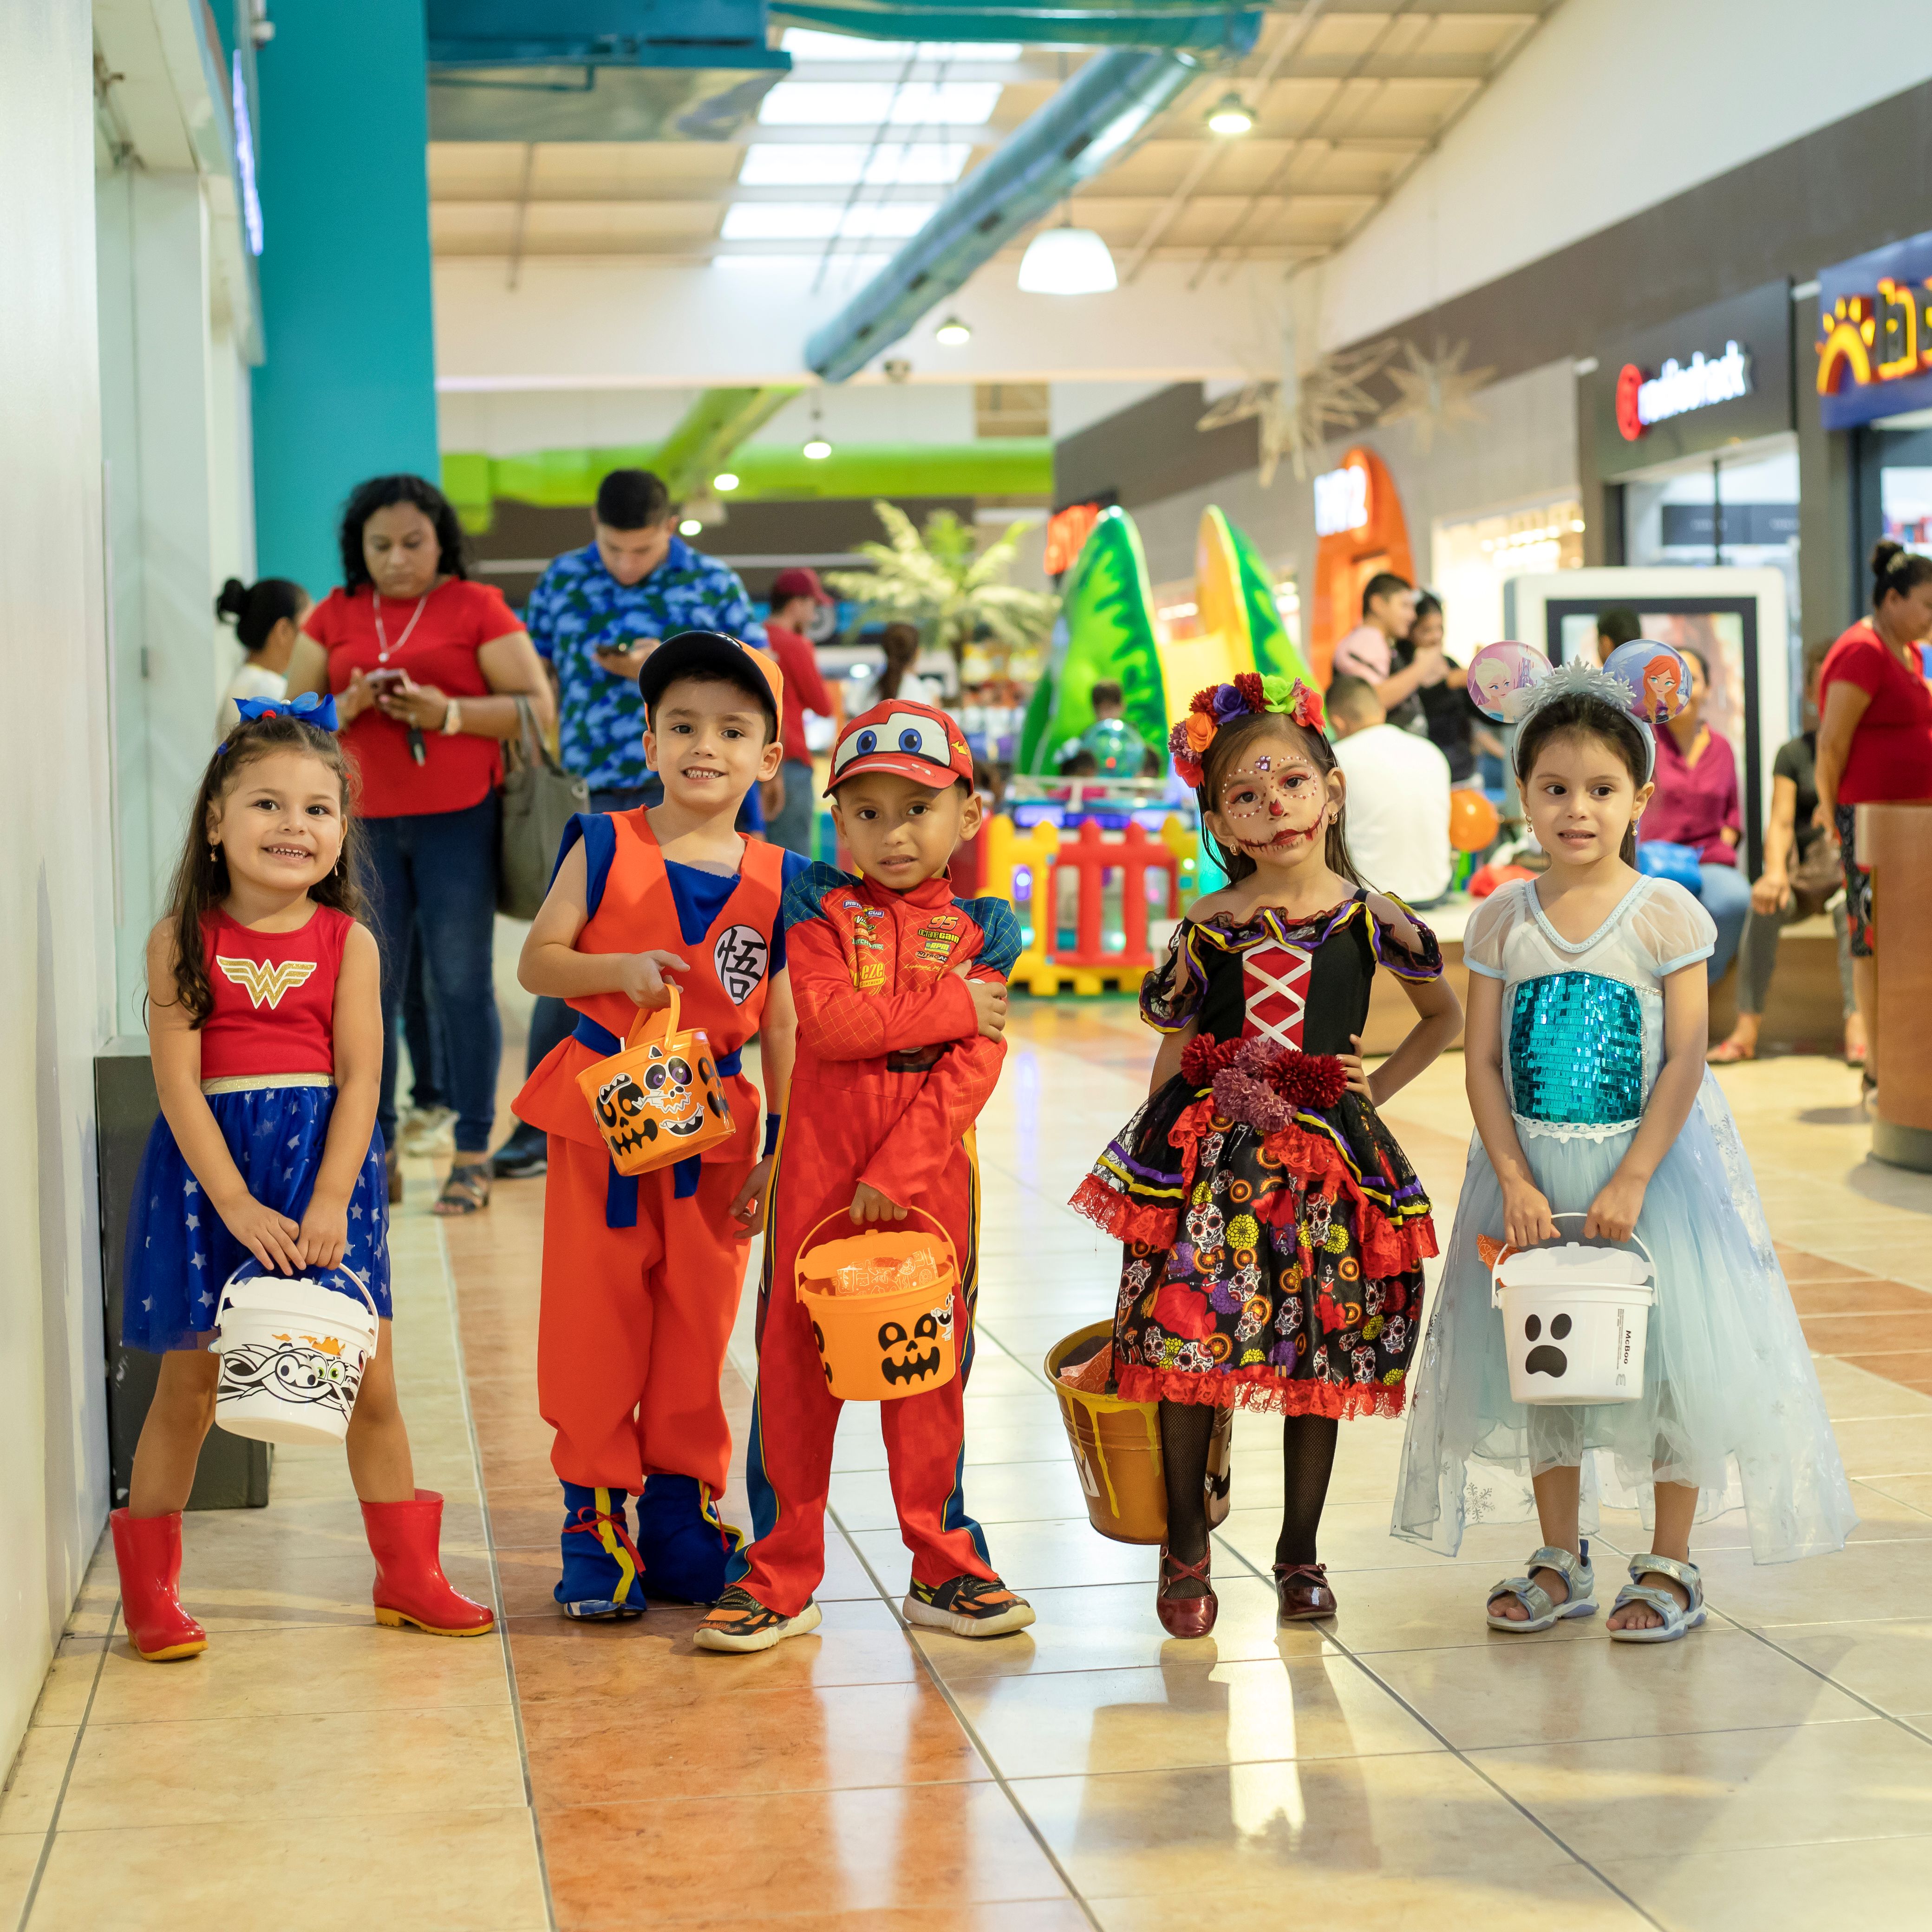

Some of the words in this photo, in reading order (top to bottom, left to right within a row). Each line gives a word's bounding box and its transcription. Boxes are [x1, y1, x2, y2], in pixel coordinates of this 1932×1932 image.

[928, 915, 959, 930] 95
[917, 952, 948, 961] NITROAD
[717, 928, 767, 1001] 悟
